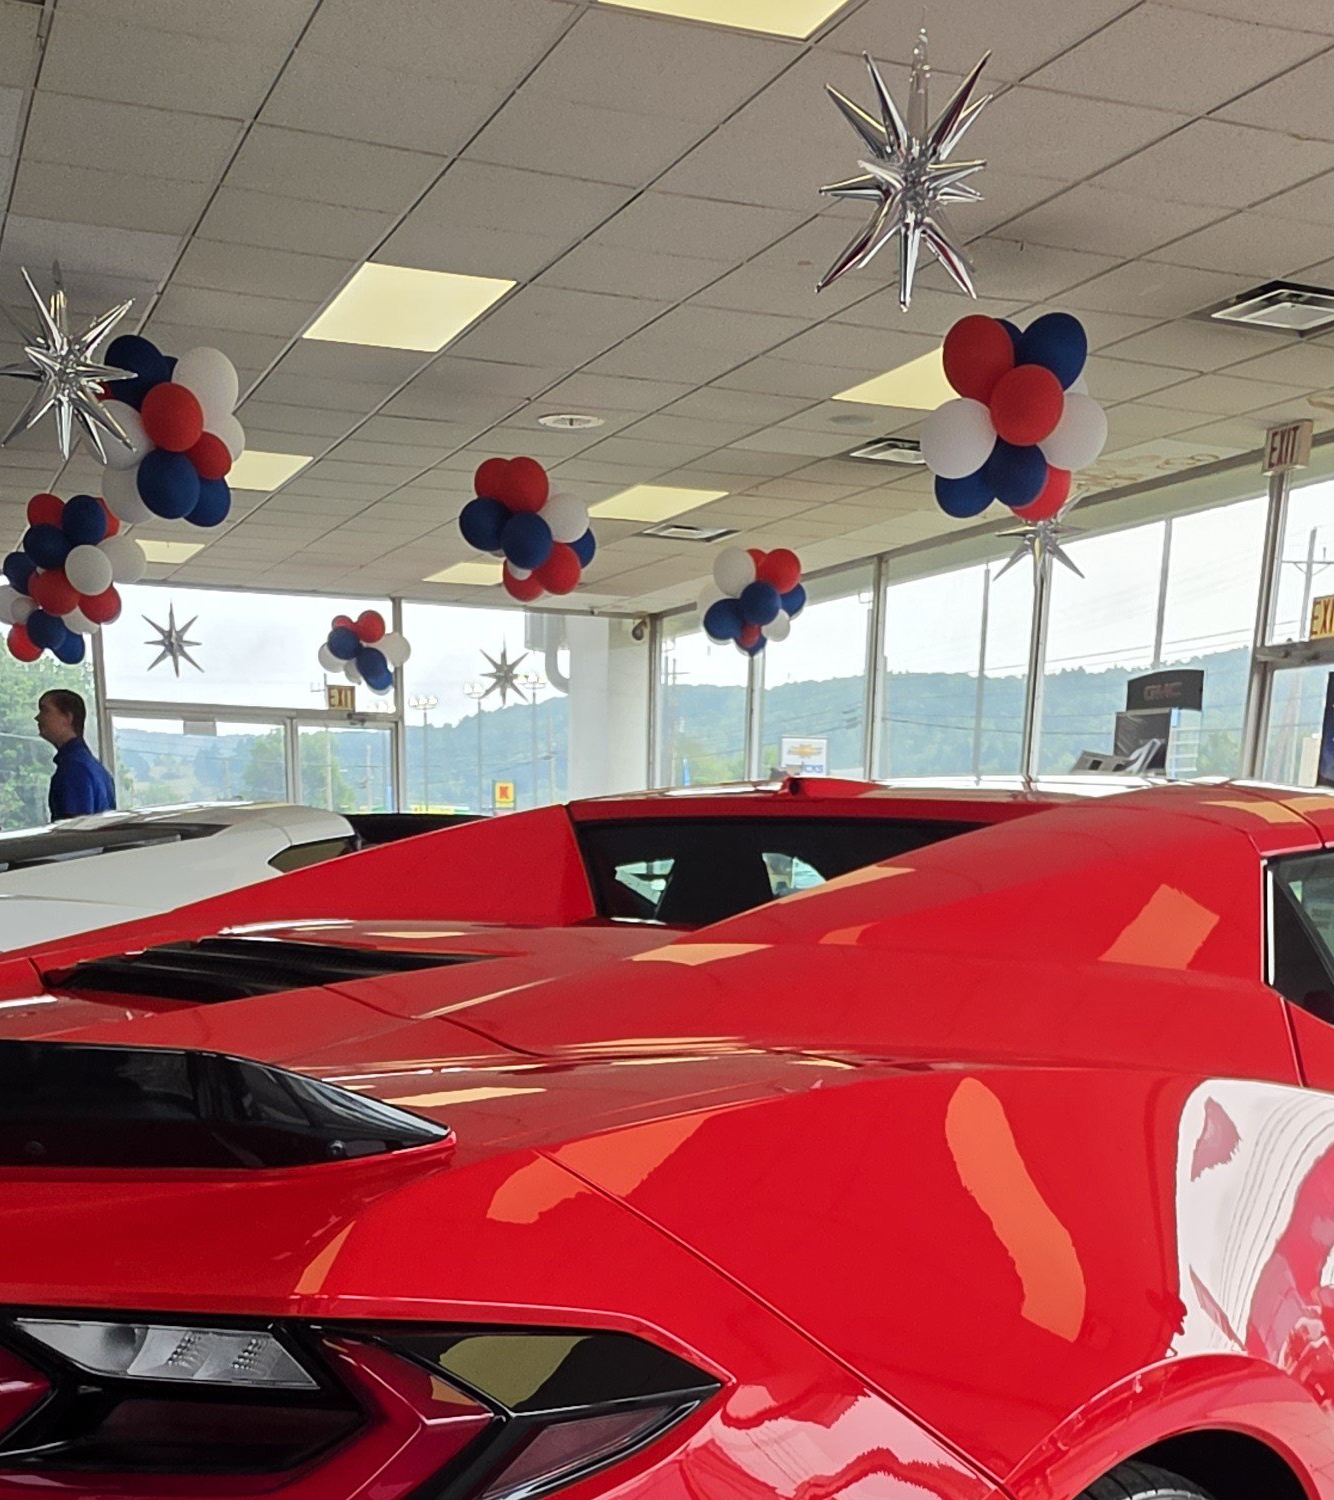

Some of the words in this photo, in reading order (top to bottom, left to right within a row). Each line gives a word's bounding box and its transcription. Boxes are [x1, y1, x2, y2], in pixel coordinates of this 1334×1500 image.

[1268, 424, 1299, 469] EXIT
[1143, 682, 1181, 700] GMC
[499, 786, 510, 799] K
